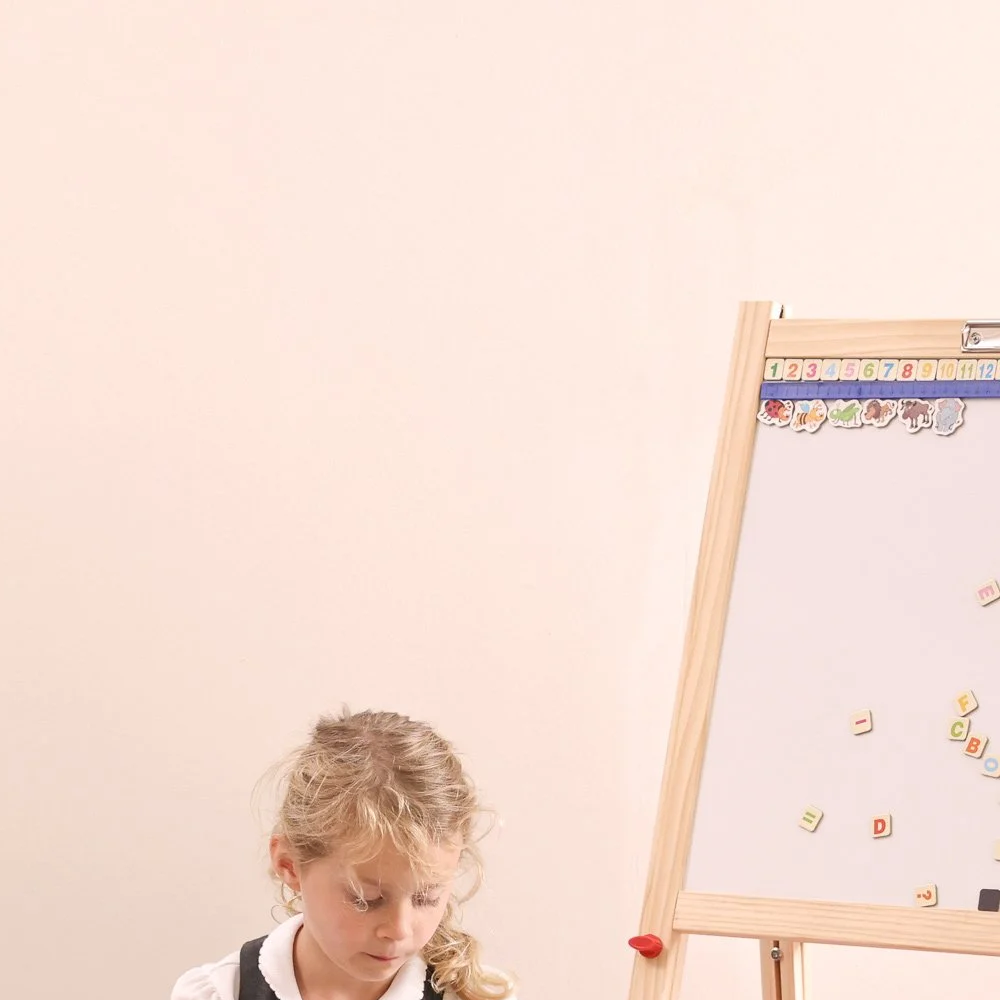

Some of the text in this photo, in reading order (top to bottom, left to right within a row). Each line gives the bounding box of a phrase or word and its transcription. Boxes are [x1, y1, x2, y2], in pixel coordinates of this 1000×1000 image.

[771, 363, 994, 379] 1 2 3 4 5 6 7 8 9 10 11 12
[958, 694, 969, 712] F
[951, 721, 964, 737] C
[966, 737, 981, 754] B
[873, 818, 886, 835] D
